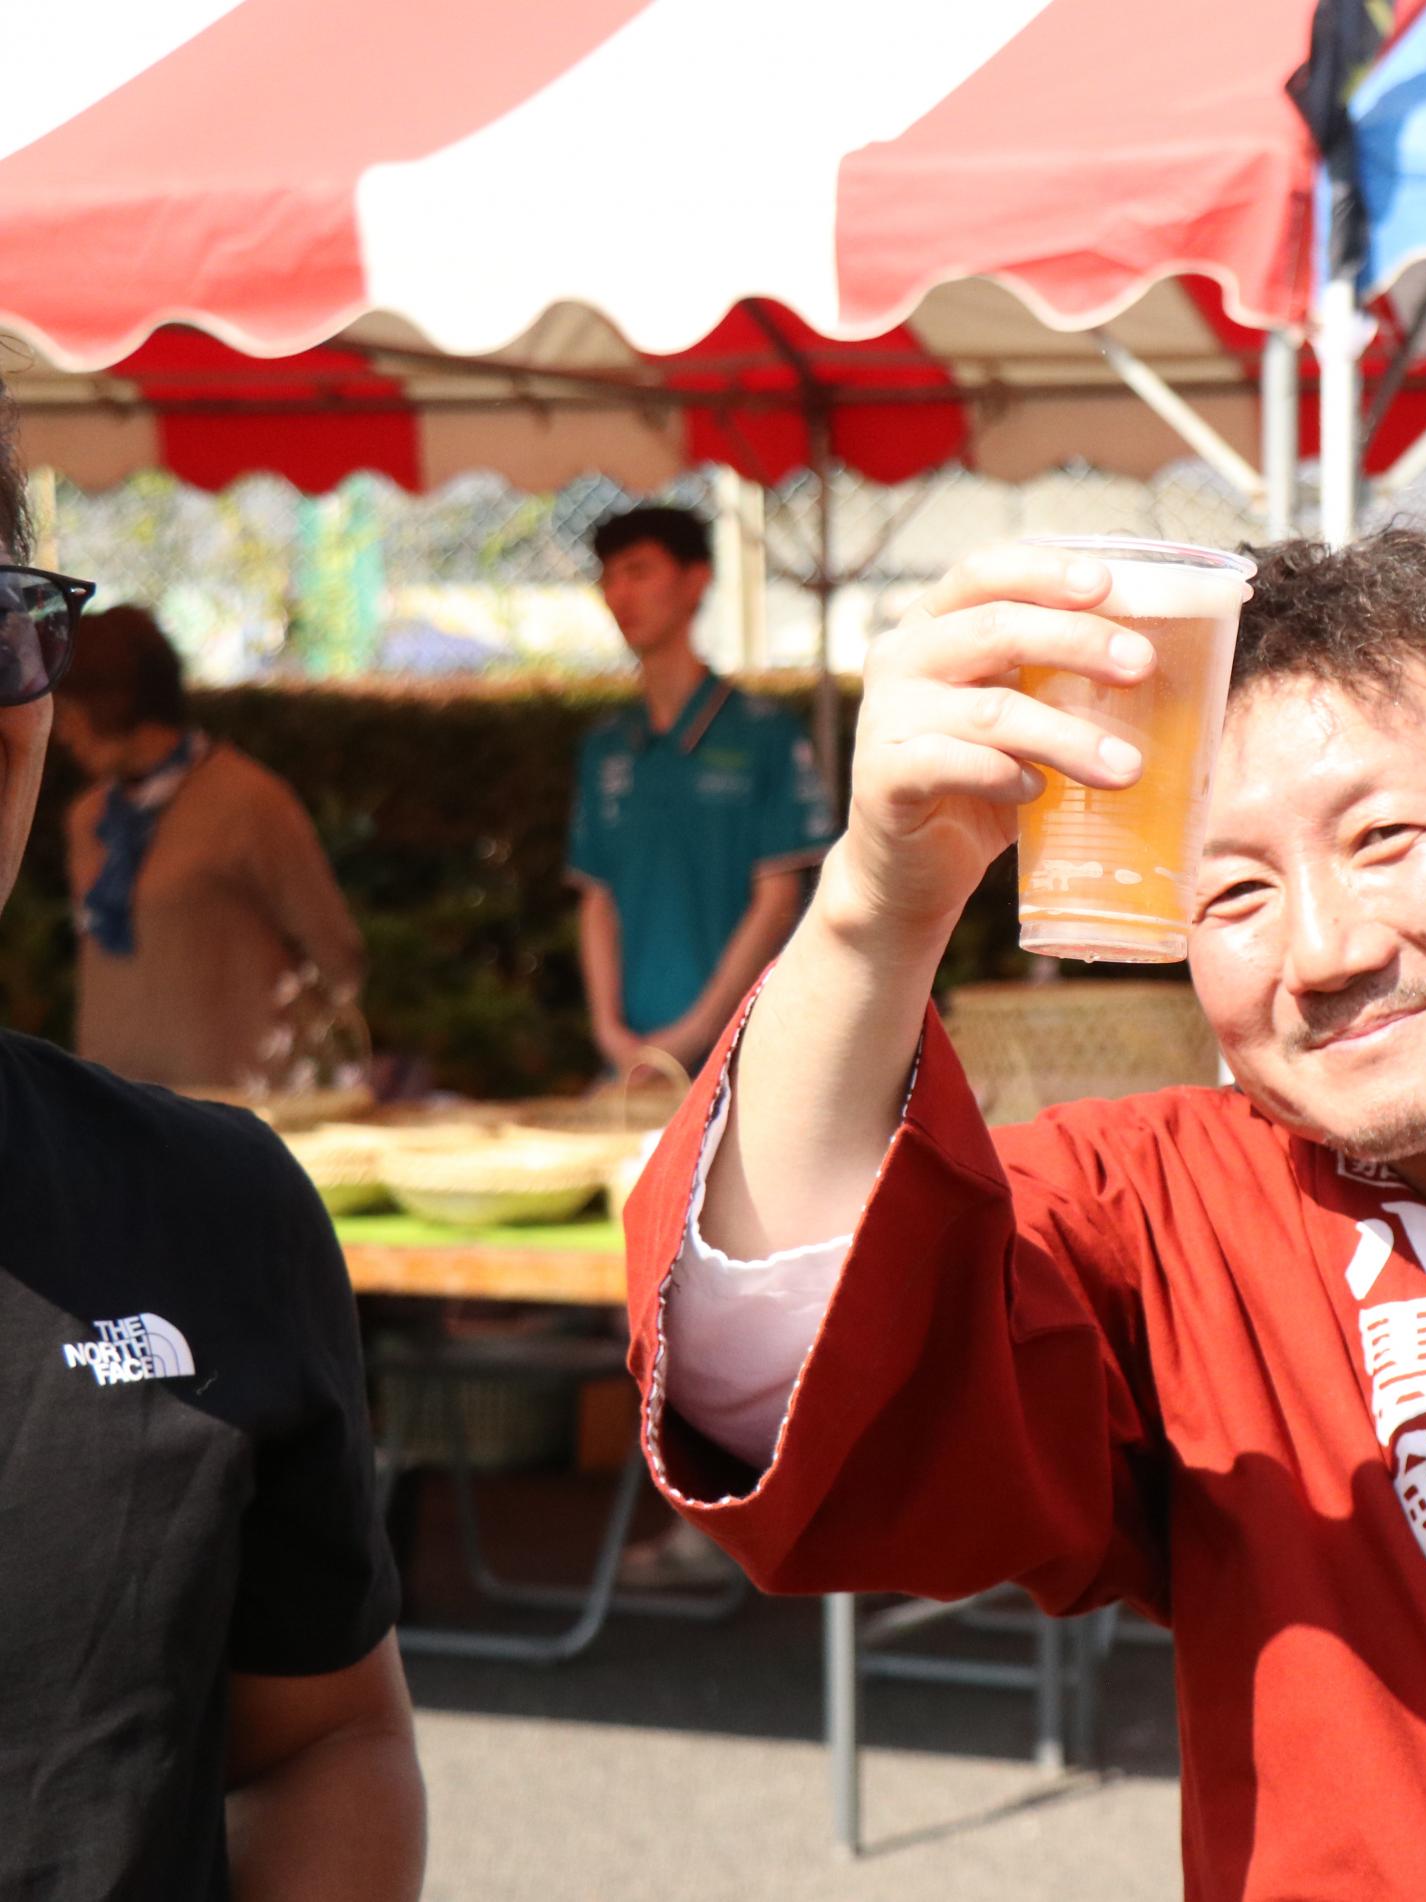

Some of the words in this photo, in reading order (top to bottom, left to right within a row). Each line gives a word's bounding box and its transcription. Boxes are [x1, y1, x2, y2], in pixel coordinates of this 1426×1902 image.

[94, 1316, 145, 1342] THE
[63, 1334, 151, 1369] NORTH
[92, 1357, 154, 1386] FACE
